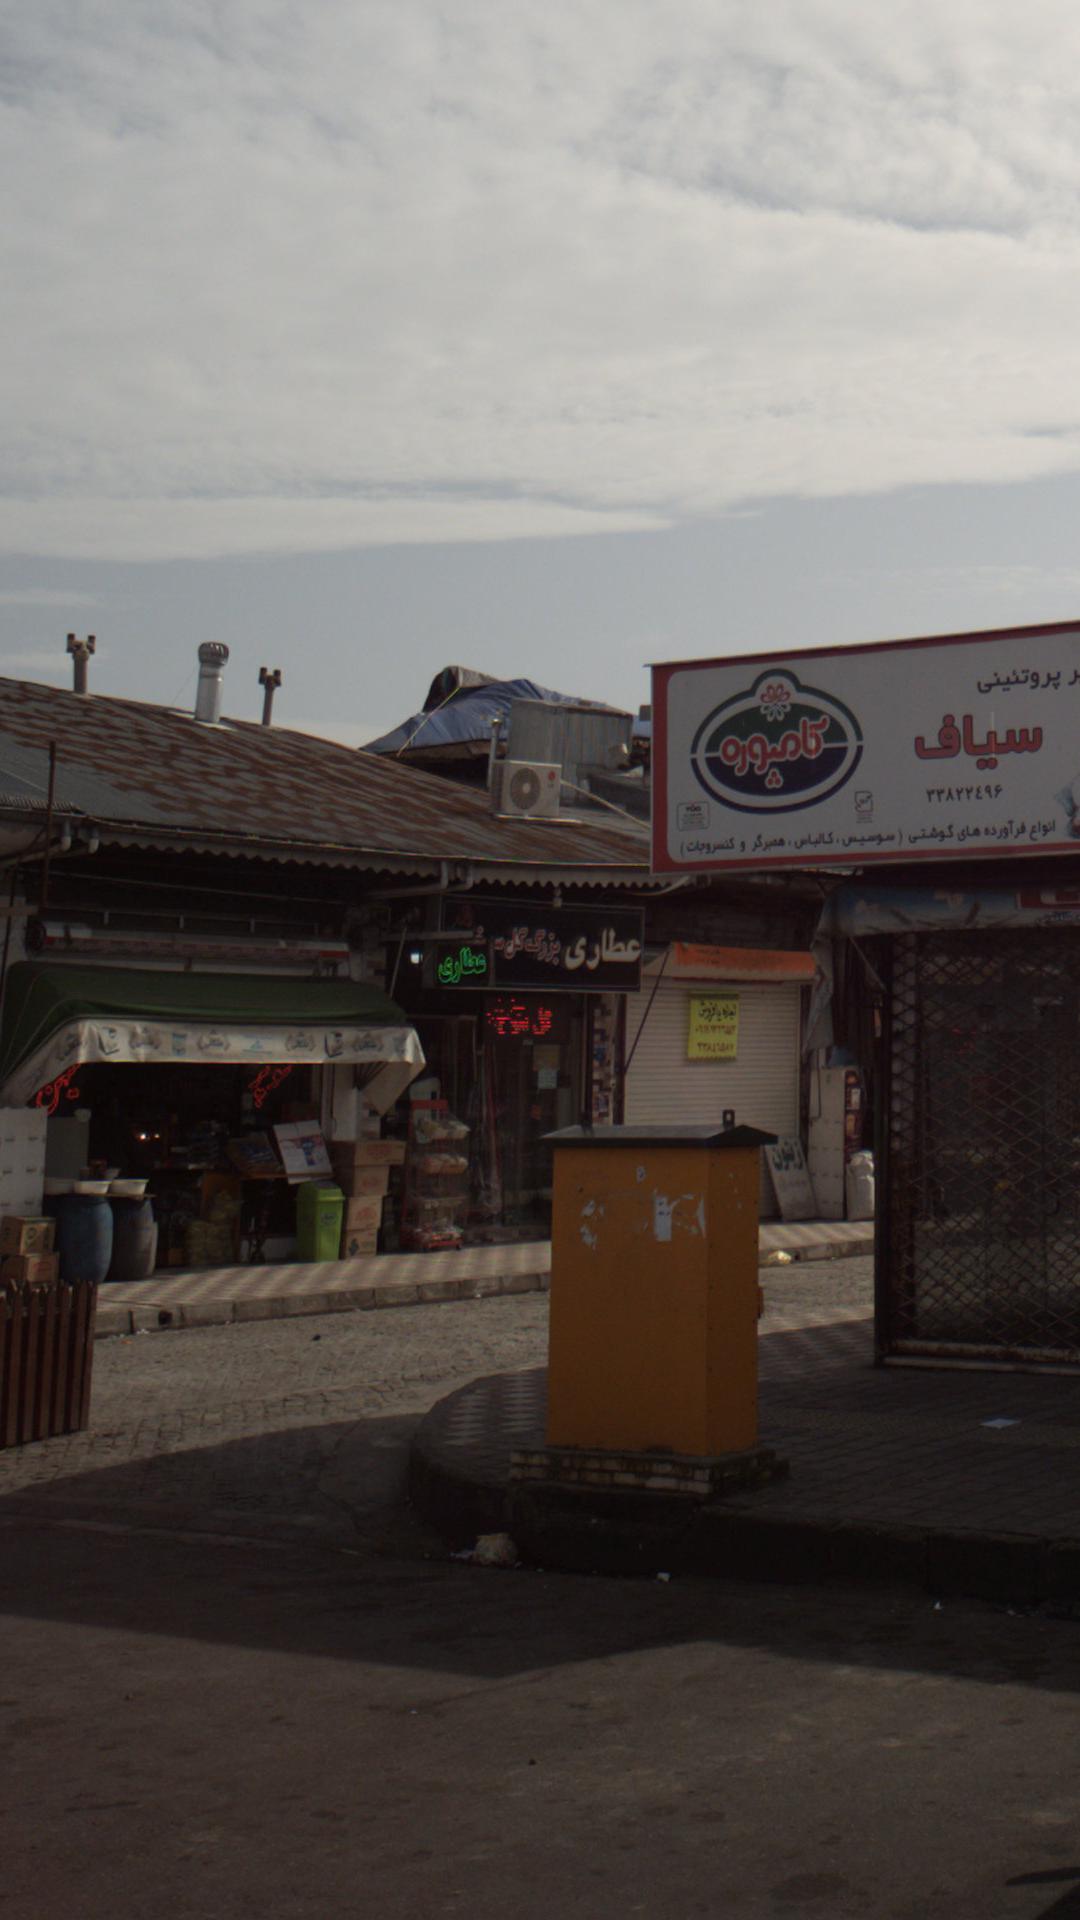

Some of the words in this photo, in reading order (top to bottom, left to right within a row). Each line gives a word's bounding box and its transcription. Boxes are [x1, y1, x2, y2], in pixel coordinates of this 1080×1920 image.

[977, 669, 1061, 694] پروتئینی
[720, 714, 829, 788] کامپوره
[914, 713, 1044, 771] سیاف
[908, 823, 954, 844] گوشتی
[957, 825, 980, 842] های
[983, 819, 1026, 840] فرآورده
[1029, 818, 1056, 841] انواع
[563, 926, 642, 971] عطاری
